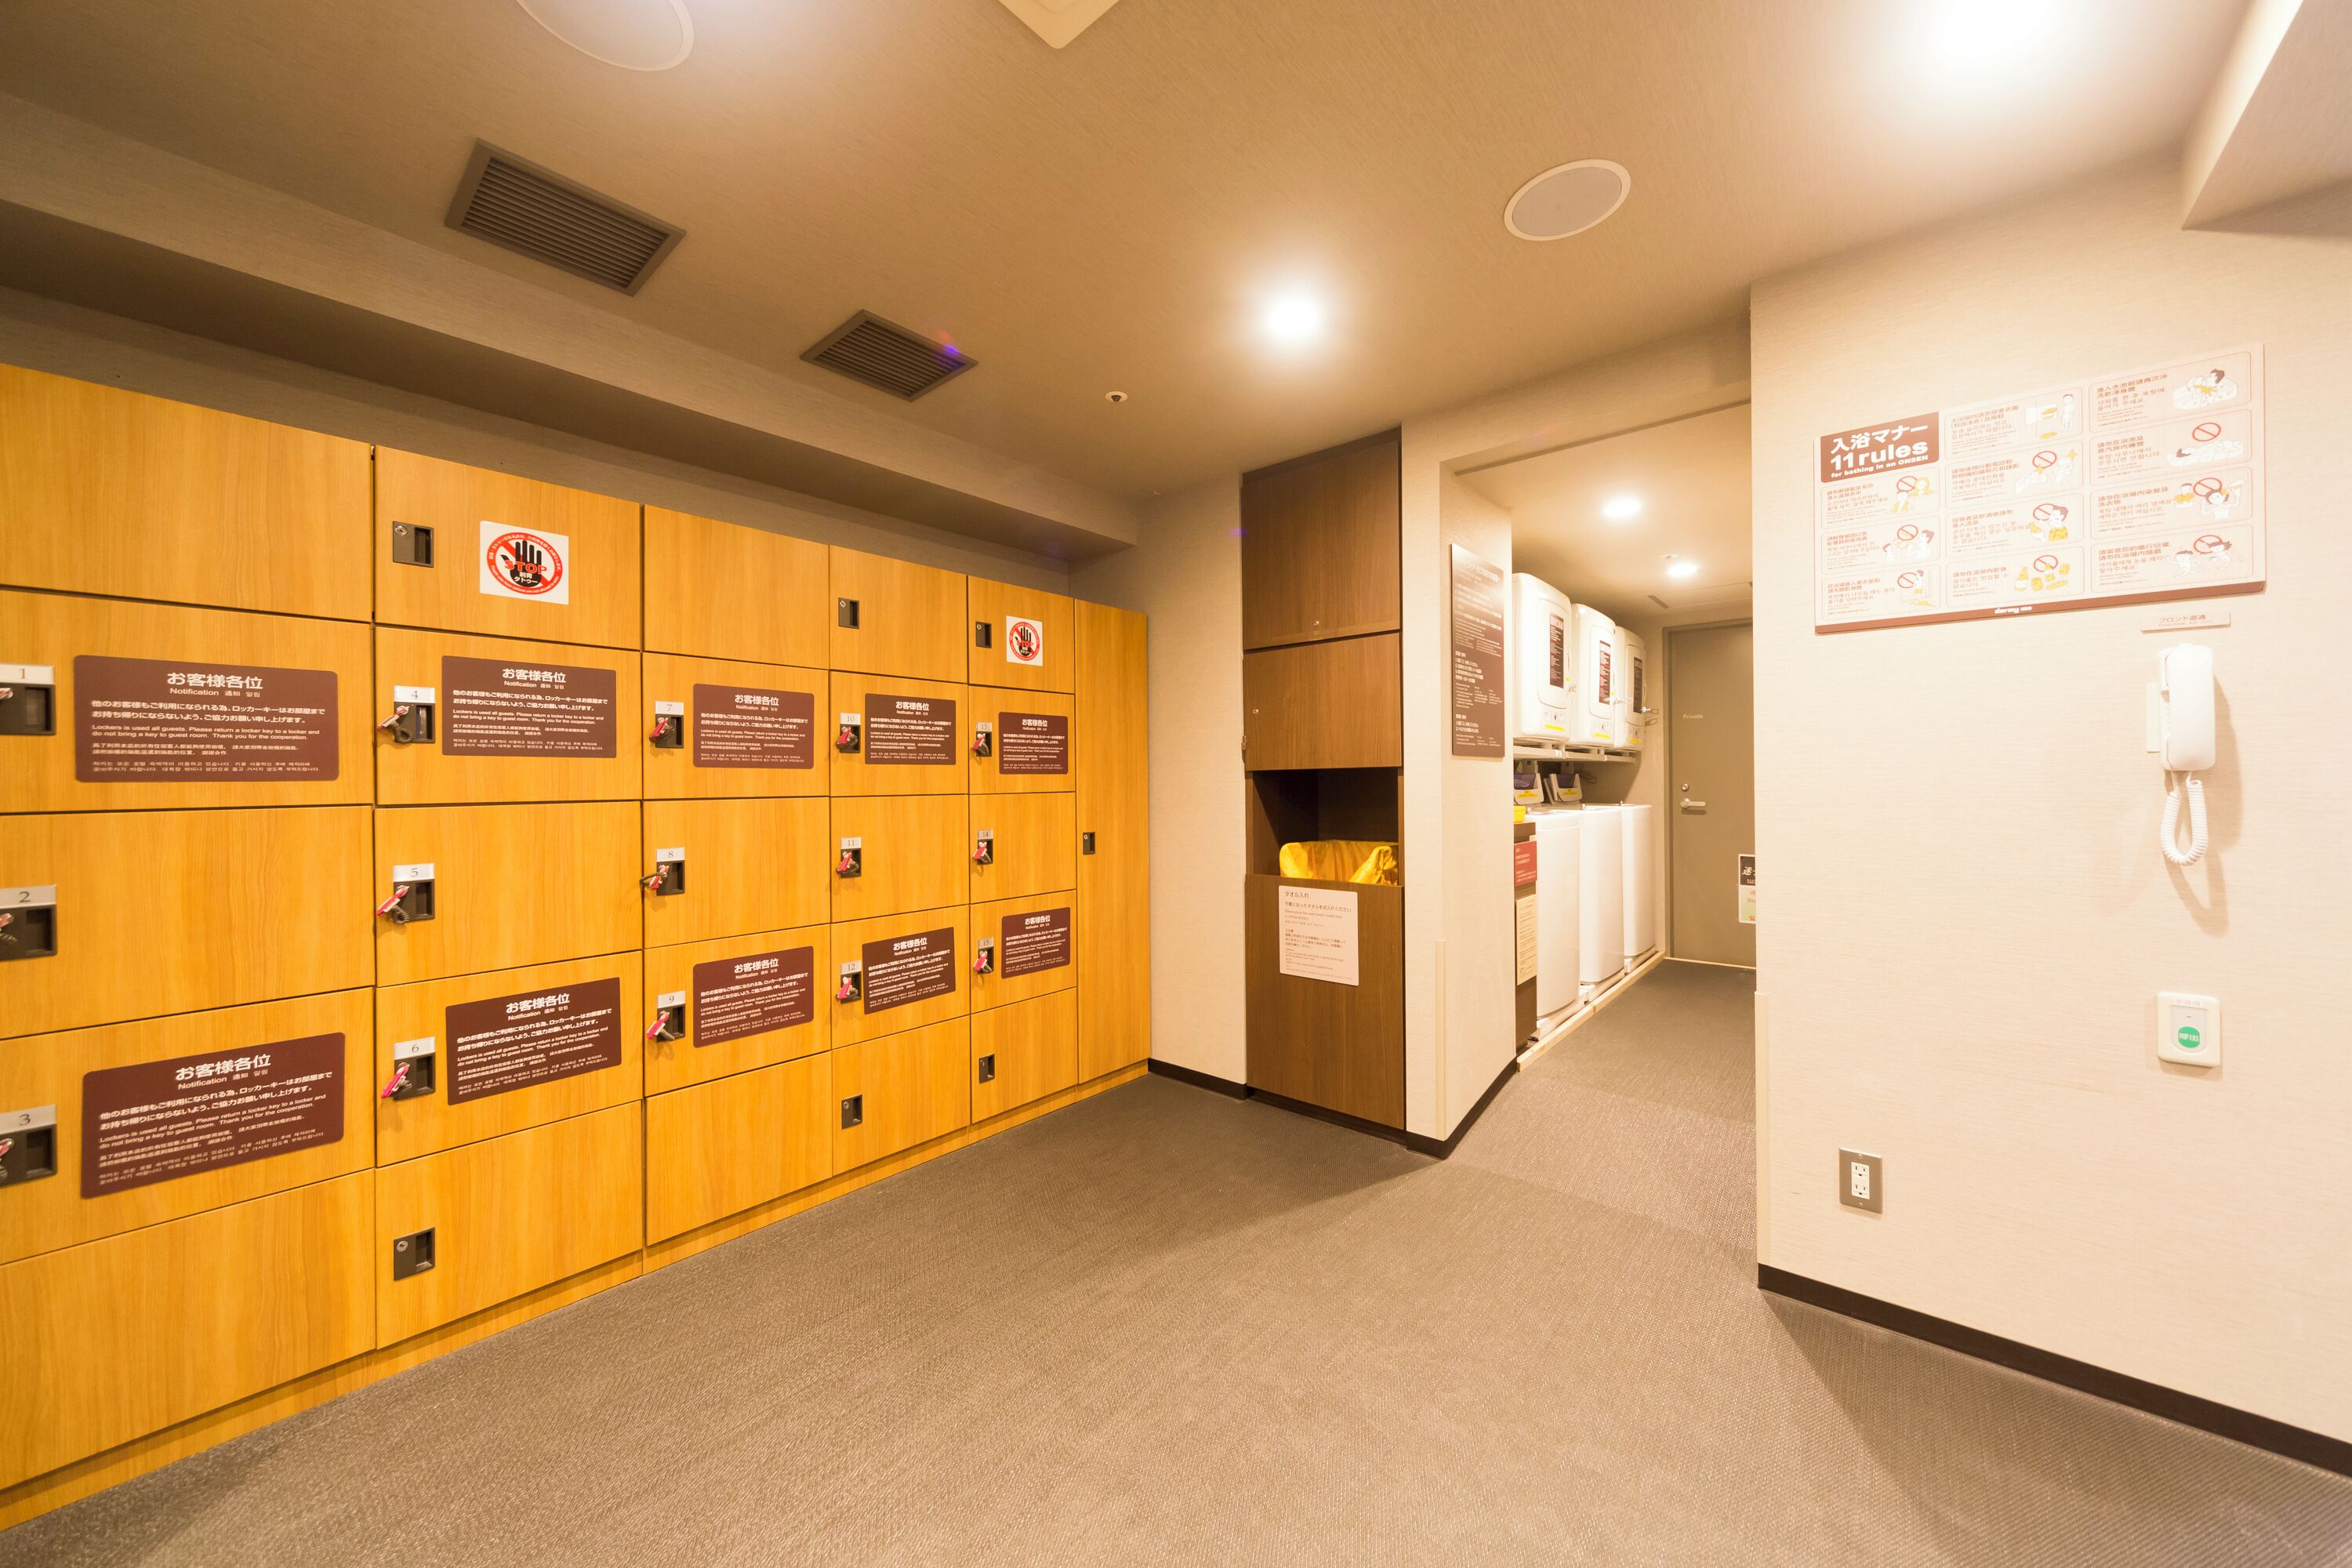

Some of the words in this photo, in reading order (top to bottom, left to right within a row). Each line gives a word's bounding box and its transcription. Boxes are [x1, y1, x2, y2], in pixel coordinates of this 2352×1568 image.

[1830, 425, 1928, 454] 入浴マナー
[1844, 466, 1874, 476] bathing
[1898, 455, 1929, 465] ONSEN
[504, 559, 547, 575] STOP
[19, 668, 26, 679] 1
[502, 667, 566, 683] お客様各位
[166, 671, 263, 689] お客様各位
[169, 687, 219, 695] Notification
[411, 690, 418, 699] 4
[734, 694, 778, 706] お客様各位
[895, 701, 929, 710] お客様各位
[411, 867, 418, 877] 5
[19, 891, 31, 902] 2
[1025, 914, 1050, 925] お客様各位
[893, 936, 927, 951] お客様各位
[734, 957, 778, 974] お客様各位
[506, 992, 569, 1014] お客様各位
[508, 1009, 540, 1020] Notification
[2180, 1033, 2198, 1042] 呼出
[412, 1043, 419, 1053] 6
[175, 1053, 271, 1082] お客様各位
[178, 1075, 226, 1090] Notification
[19, 1114, 31, 1125] 3
